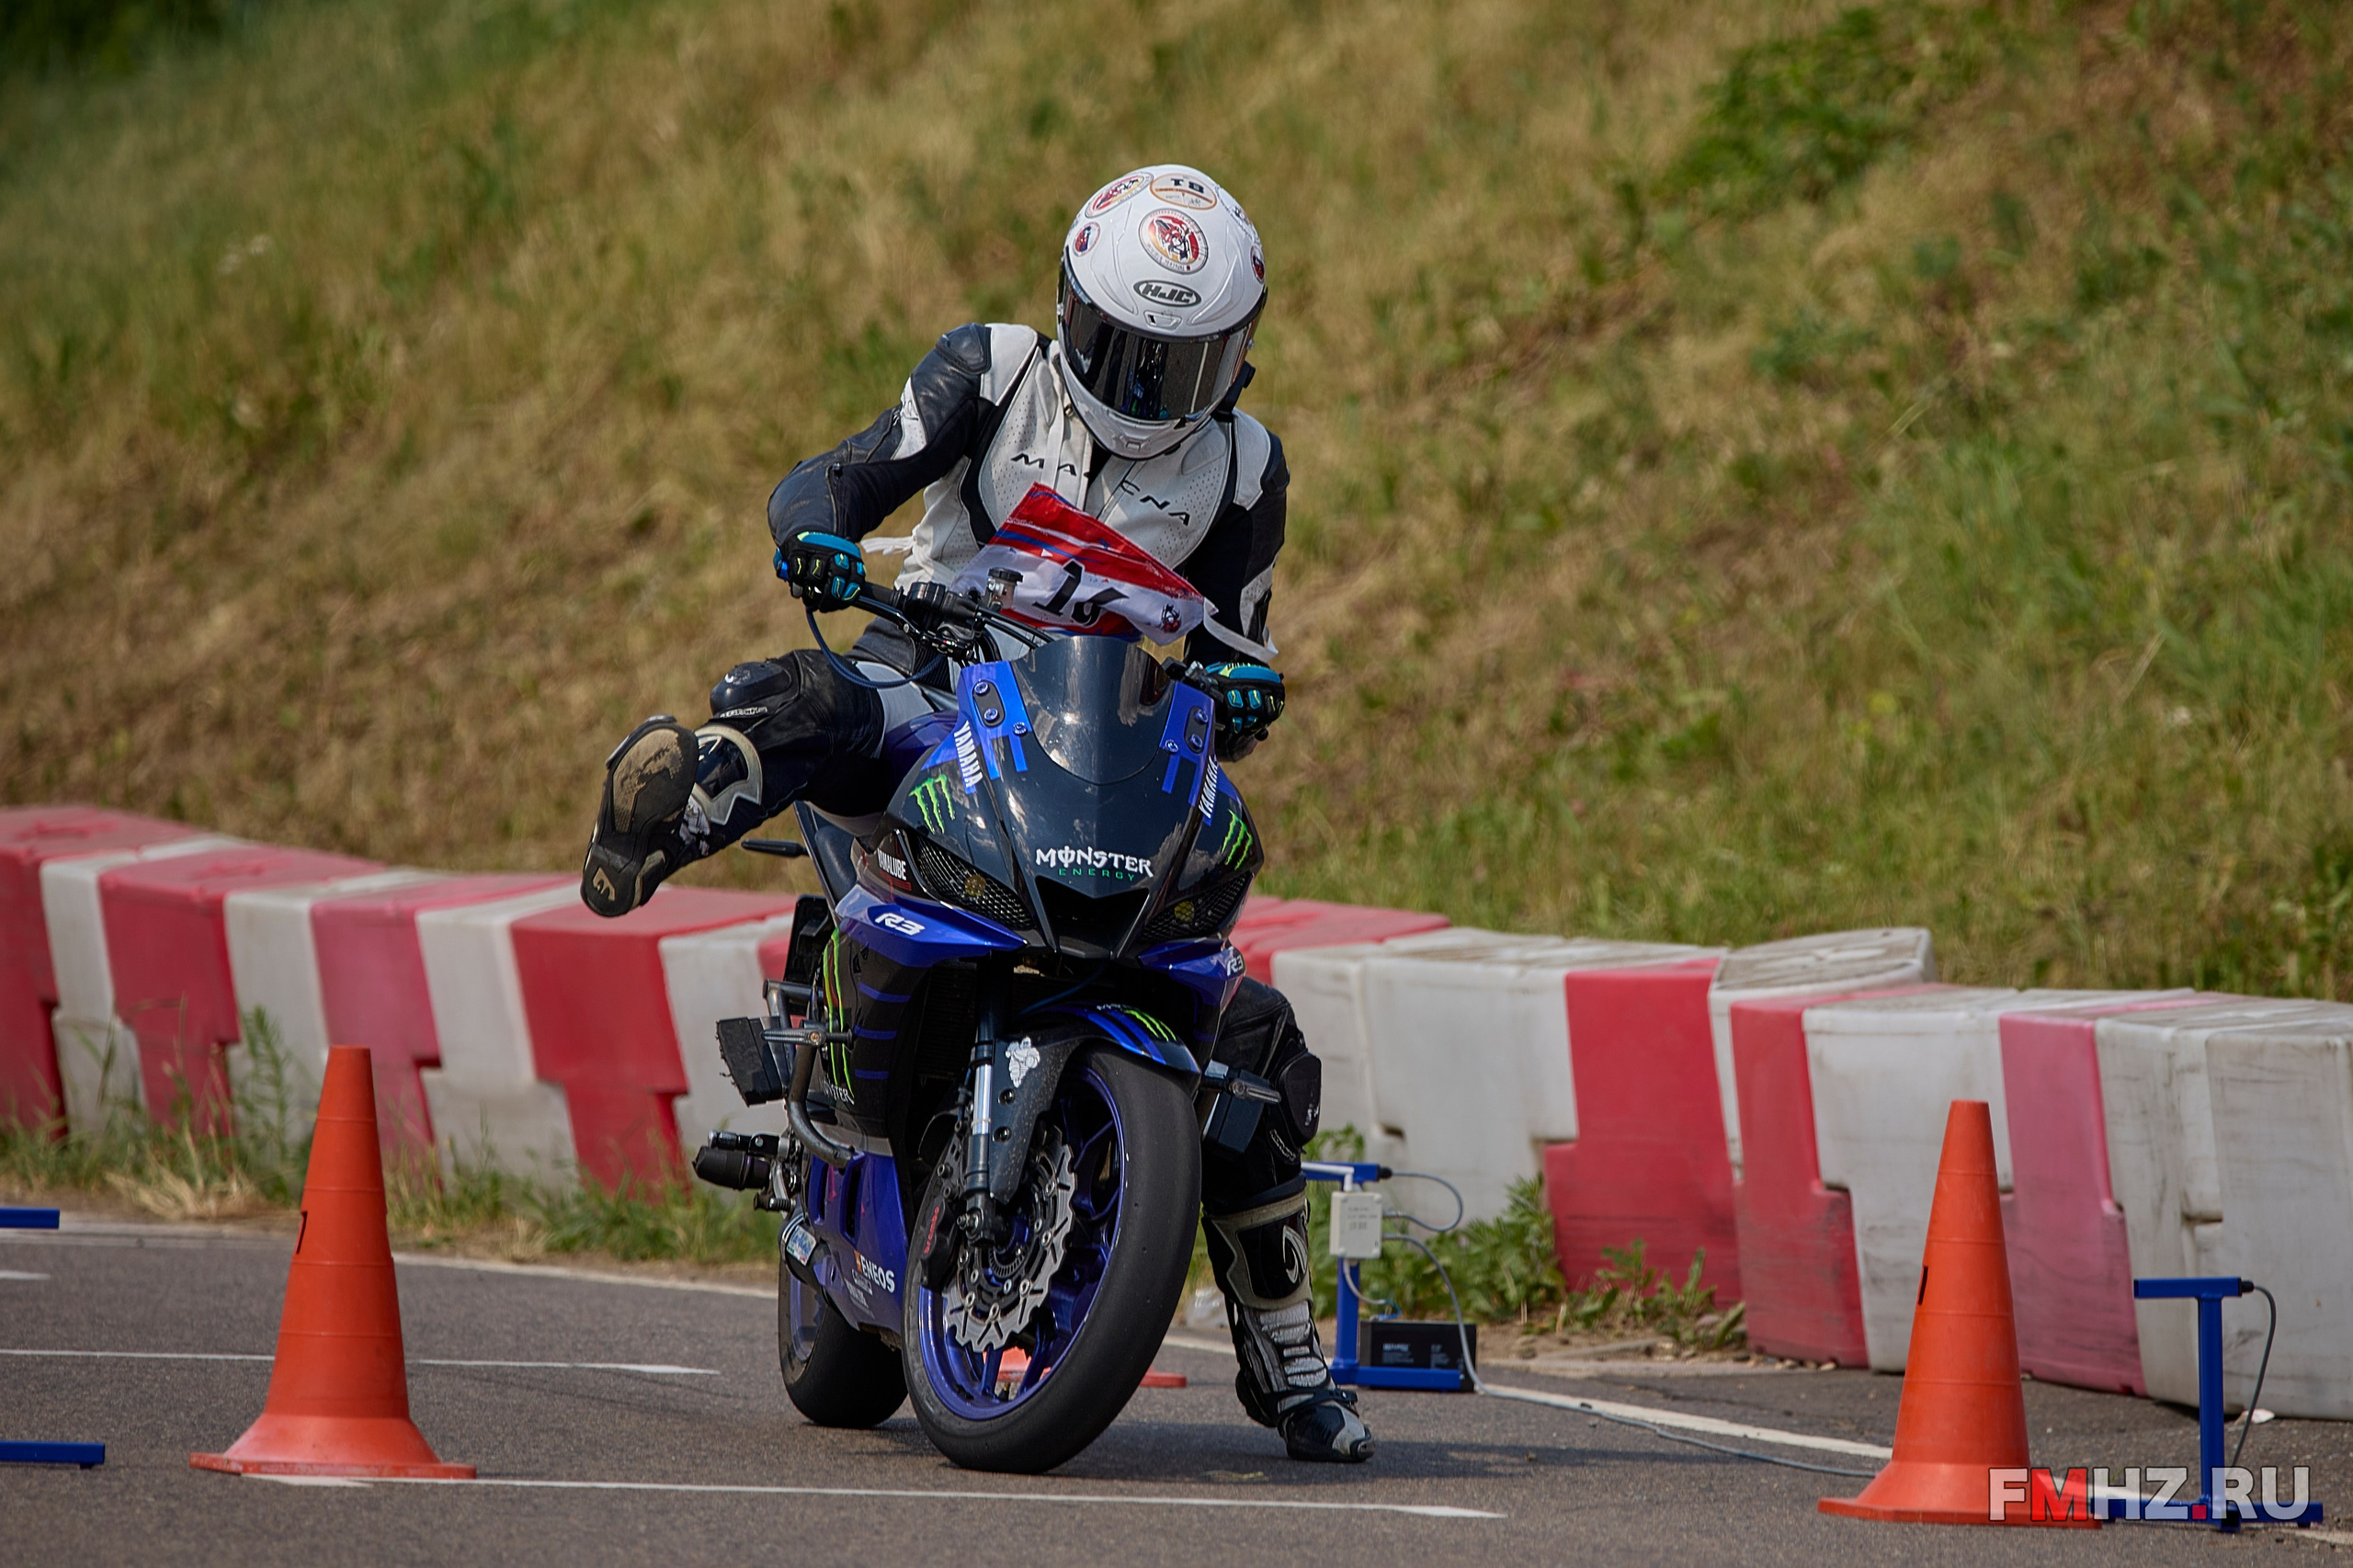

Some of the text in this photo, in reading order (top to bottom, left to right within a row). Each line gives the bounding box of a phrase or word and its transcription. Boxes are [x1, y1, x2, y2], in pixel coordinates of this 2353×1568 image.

[1142, 283, 1193, 303] HJC
[953, 720, 983, 789] YAMAHA
[1198, 754, 1218, 819] YAMAHA
[1035, 845, 1154, 878] MONSTER
[1058, 868, 1135, 881] ENERGY
[874, 912, 926, 937] R3
[860, 1254, 895, 1294] ENEOS
